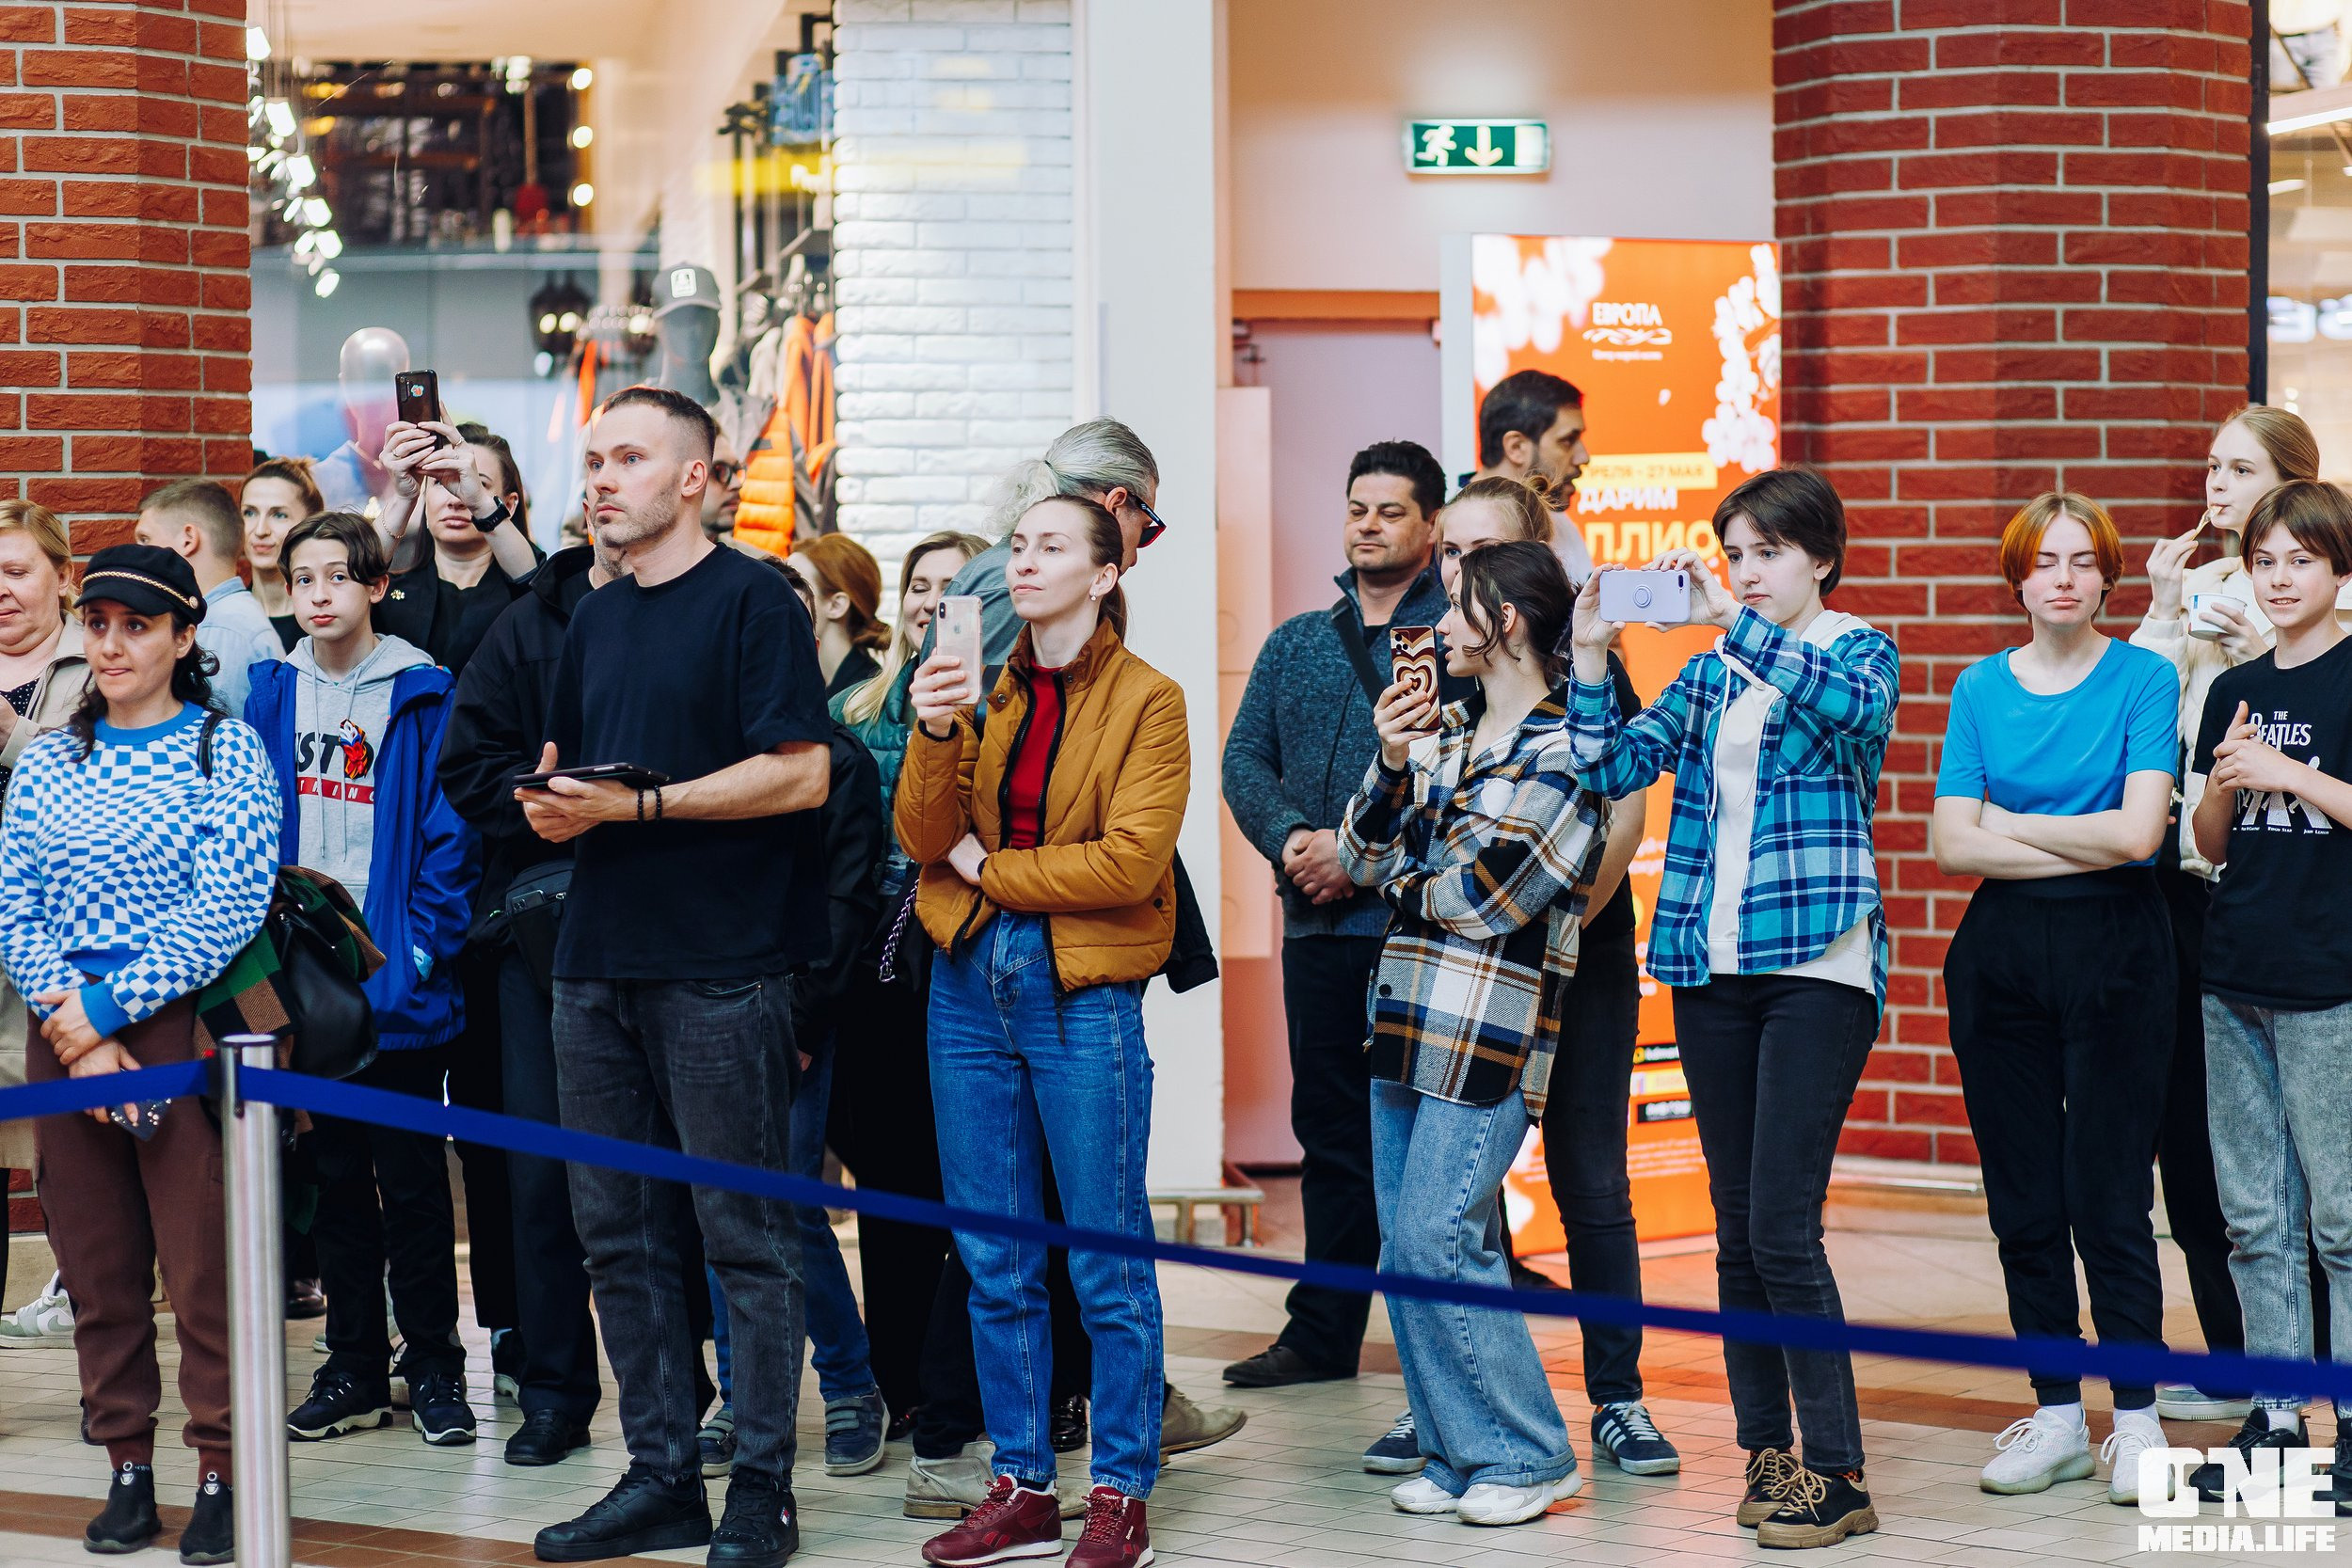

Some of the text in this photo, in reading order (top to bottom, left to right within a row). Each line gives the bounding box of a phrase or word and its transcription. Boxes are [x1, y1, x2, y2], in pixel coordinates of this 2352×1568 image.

[1593, 302, 1663, 325] ЕВРОПА
[1578, 486, 1678, 515] ДАРИМ
[2273, 710, 2288, 721] THE
[295, 731, 341, 774] ST
